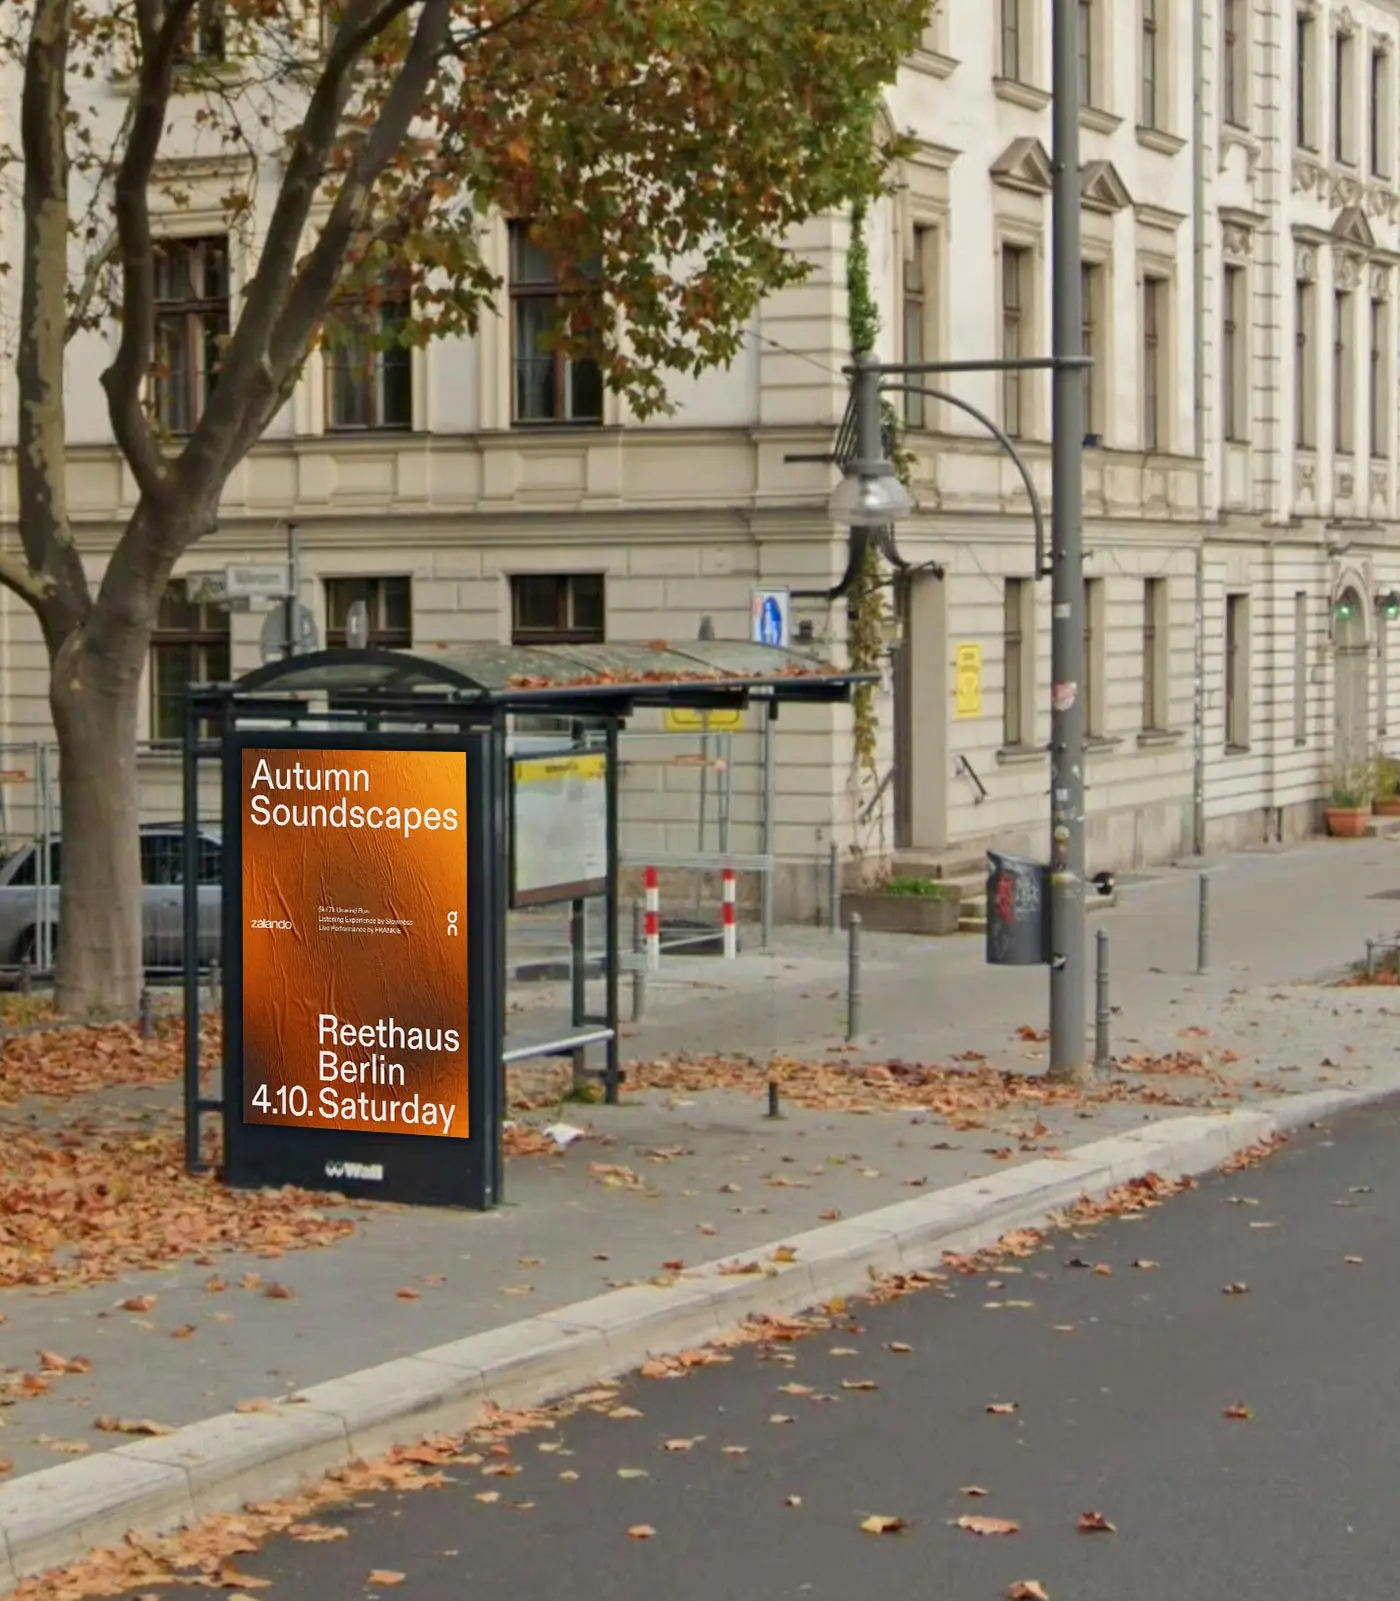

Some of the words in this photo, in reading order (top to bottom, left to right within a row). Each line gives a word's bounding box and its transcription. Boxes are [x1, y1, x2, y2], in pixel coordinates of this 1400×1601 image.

[250, 758, 370, 792] Autumn
[250, 795, 458, 838] Soundscapes
[251, 919, 292, 930] zalando
[318, 915, 344, 925] Listening
[345, 917, 376, 926] Experience
[331, 926, 367, 934] Performance
[318, 1014, 460, 1052] Reethaus
[318, 1050, 405, 1086] Berlin
[251, 1083, 314, 1117] 4.10.
[317, 1086, 456, 1135] Saturday
